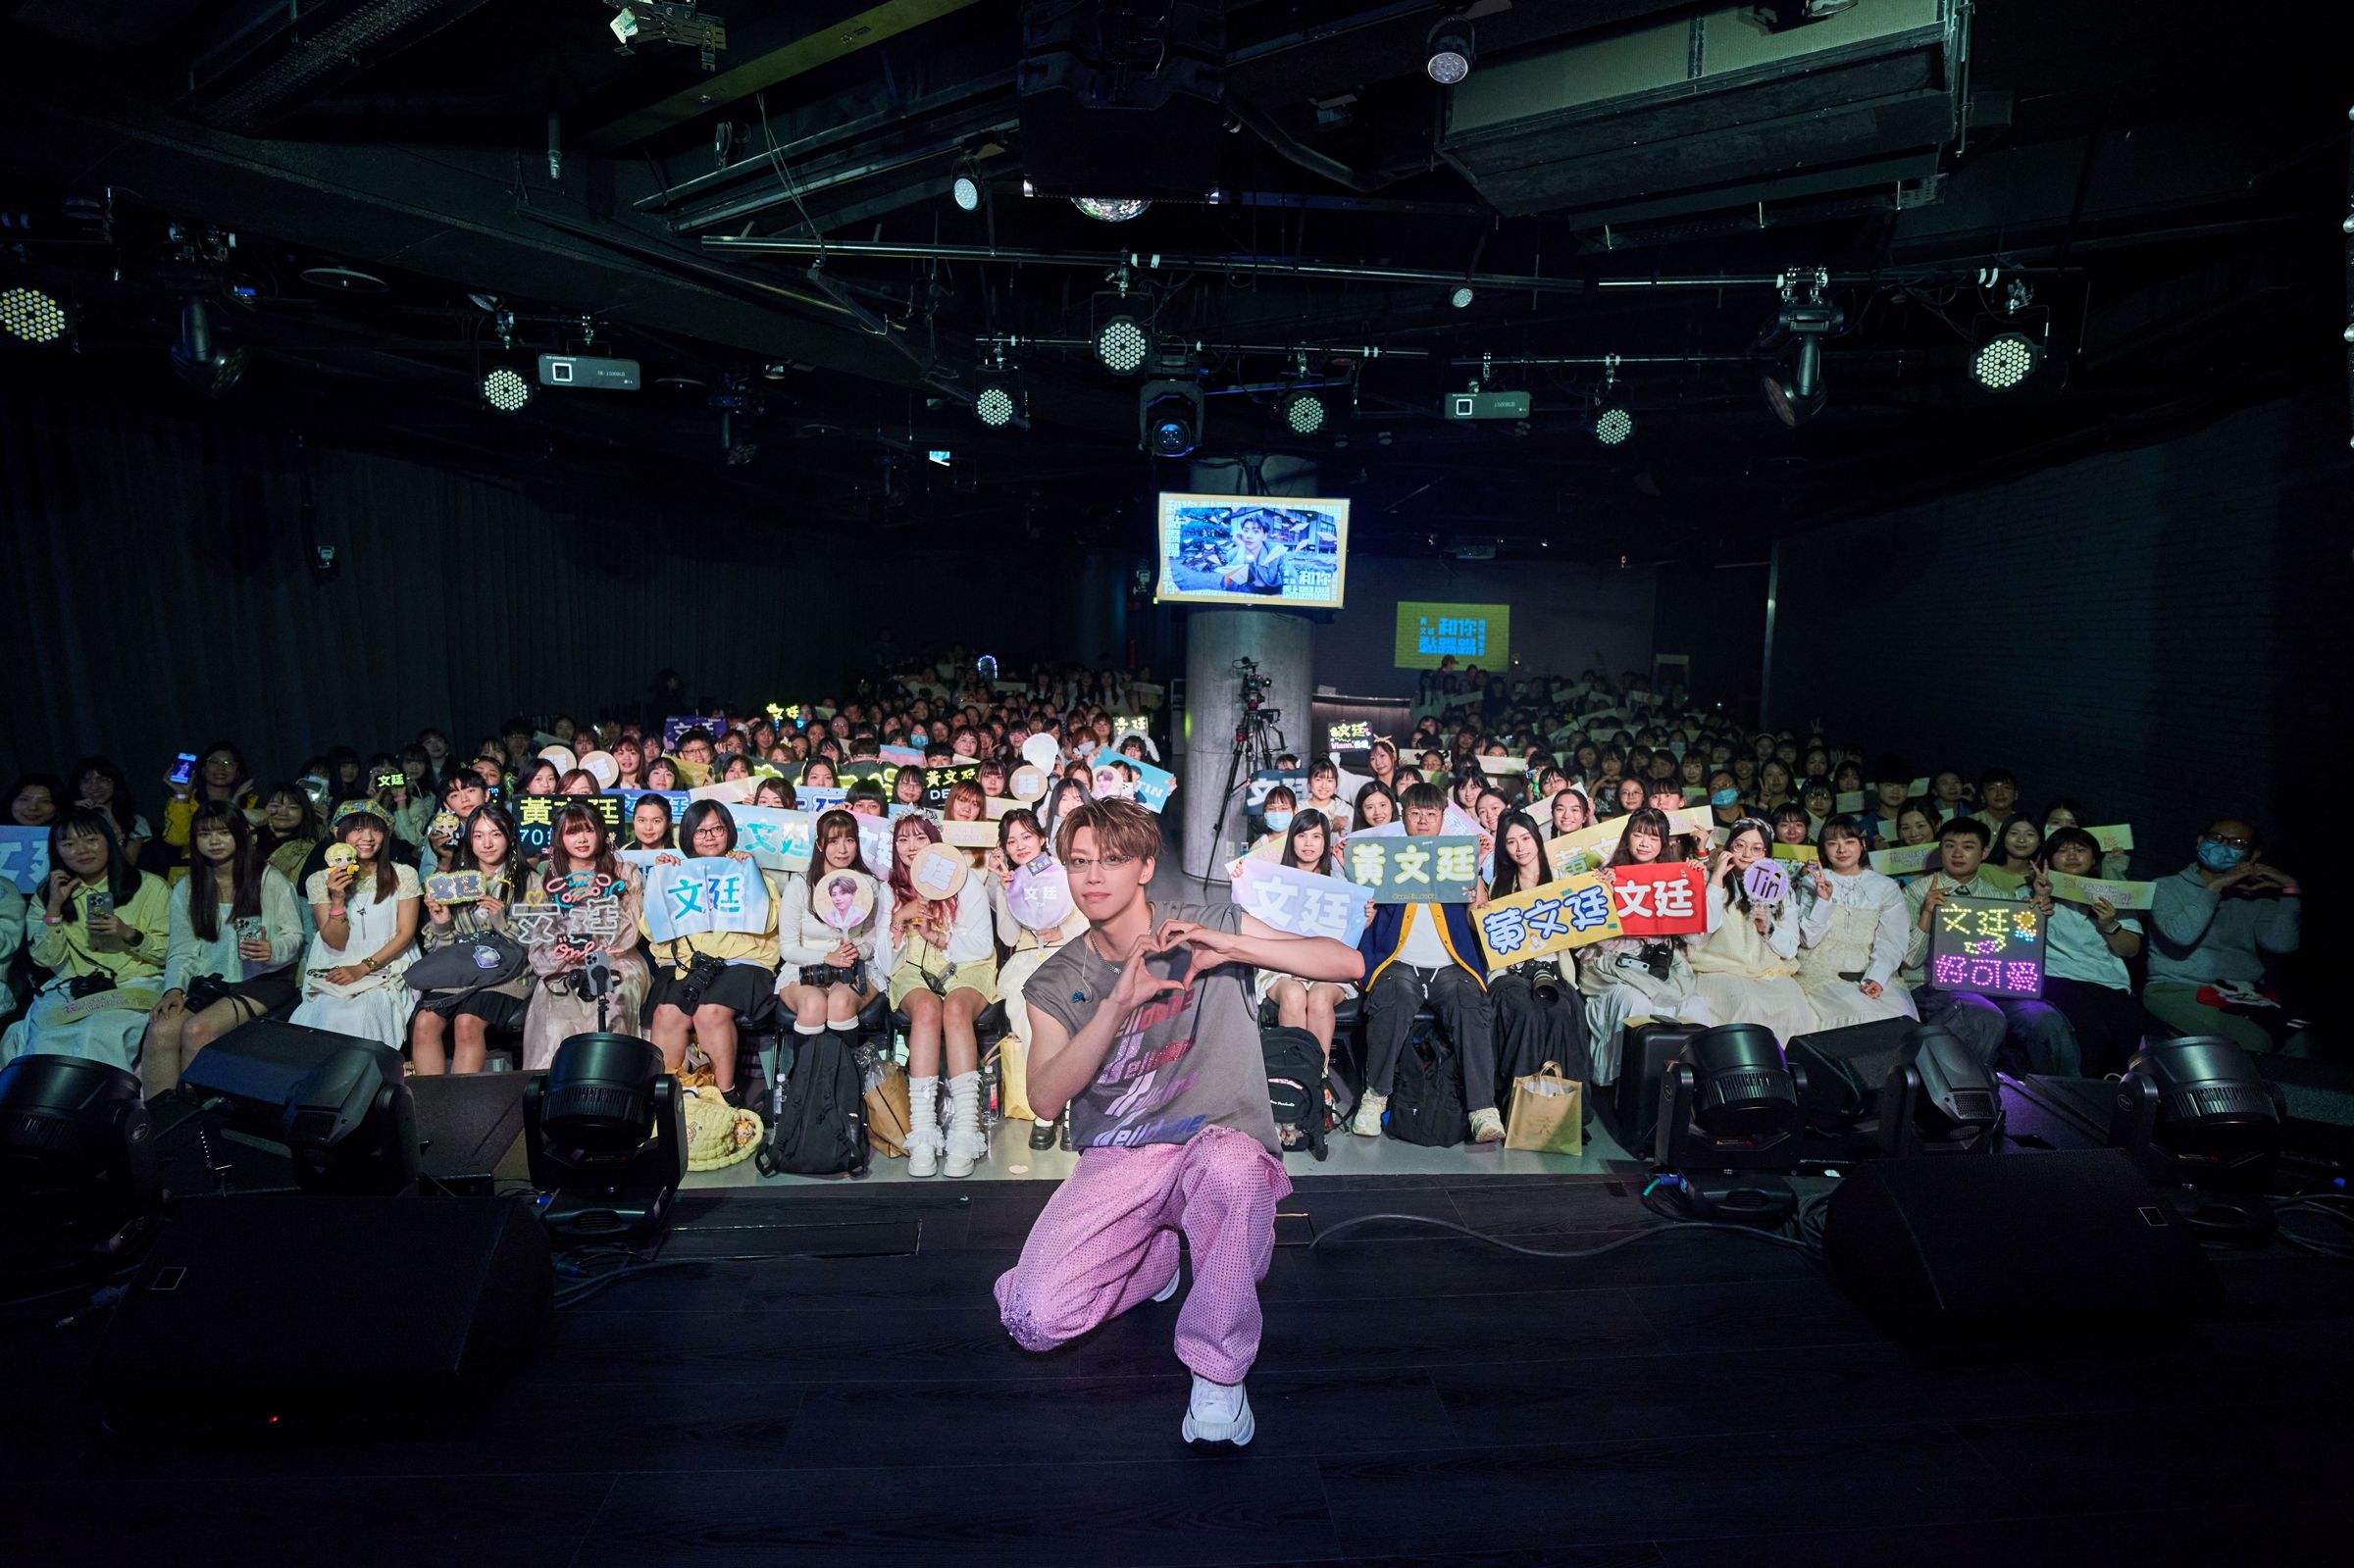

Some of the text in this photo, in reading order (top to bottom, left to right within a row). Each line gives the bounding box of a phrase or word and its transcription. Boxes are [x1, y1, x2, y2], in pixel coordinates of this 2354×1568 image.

[378, 773, 405, 786] 文廷
[520, 797, 620, 826] 黃廷
[1352, 843, 1476, 886] 黃文廷
[1751, 866, 1781, 899] Tin
[668, 876, 741, 920] 文廷
[1024, 885, 1057, 901] 文廷
[1252, 876, 1352, 940] 文廷
[1614, 879, 1694, 919] 文廷
[512, 894, 620, 946] 文廷
[1482, 884, 1610, 956] 黃文廷
[1940, 902, 2010, 945] 文廷
[1935, 954, 2038, 992] 好可愛
